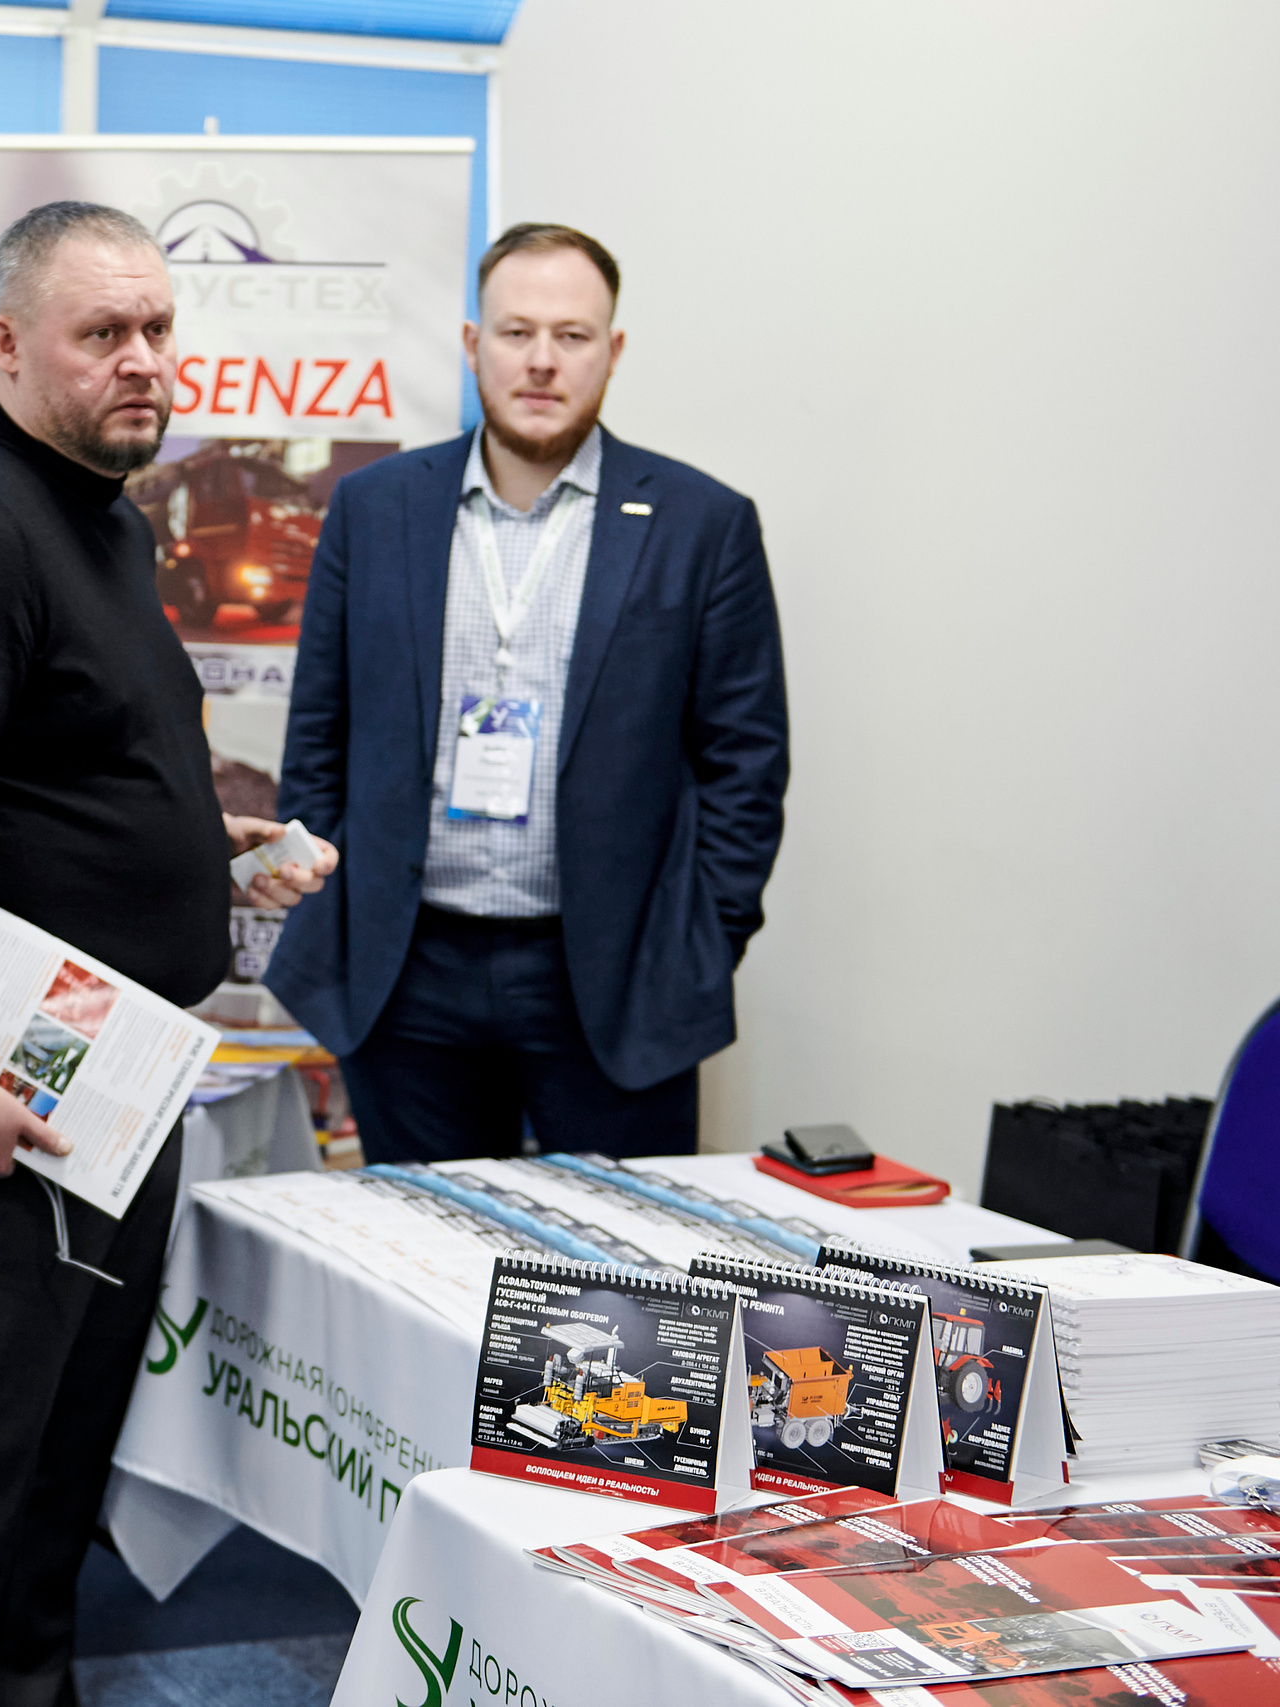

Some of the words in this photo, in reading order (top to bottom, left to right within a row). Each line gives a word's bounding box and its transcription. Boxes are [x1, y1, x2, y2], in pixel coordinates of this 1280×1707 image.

[498, 1275, 581, 1297] АСФАЛЬТОУКЛАДЧИК
[496, 1287, 547, 1304] ГУСЕНИЧНЫЙ
[494, 1298, 531, 1311] АСФ-Г-4-04
[532, 1304, 537, 1312] С
[537, 1305, 569, 1318] ГАЗОВЫМ
[570, 1310, 610, 1324] ОБОГРЕВОМ
[700, 1307, 730, 1320] ГКМП
[749, 1299, 785, 1316] РЕМОНТА
[1007, 1305, 1034, 1318] ГКМП
[887, 1316, 917, 1330] ГКМП
[489, 1333, 522, 1344] ПЛАТФОРМА
[209, 1307, 324, 1396] ДОРОЖНАЯ
[489, 1341, 518, 1352] ОПЕРАТОРА
[671, 1349, 697, 1360] СИЛОВОЙ
[696, 1353, 720, 1363] АГРЕГАТ
[689, 1371, 718, 1382] КОНВЕЙЕР
[861, 1363, 887, 1376] РАБОЧИЙ
[886, 1368, 905, 1379] ОРГАН
[483, 1376, 504, 1386] НАГРЕВ
[670, 1376, 717, 1390] ДВУХЛЕНТОЧНЫЙ
[866, 1397, 900, 1411] УПРАВЛЕНИЯ
[883, 1392, 901, 1402] ПУЛЬТ
[480, 1404, 503, 1415] РАБОЧАЯ
[202, 1351, 374, 1511] УРАЛЬСКИЙ
[689, 1426, 711, 1437] БУНКЕР
[983, 1429, 1010, 1442] НАВЕСНОЕ
[991, 1422, 1011, 1434] ЗАДНЕЕ
[968, 1434, 1009, 1451] ОБОРУДОВАНИЕ
[841, 1442, 892, 1461] ЖИДКОТОПЛИВНАЯ
[624, 1456, 645, 1467] ШНЕКИ
[673, 1455, 708, 1468] ГУСЕНИЧНЫЙ
[865, 1456, 891, 1469] ГОРЕЛКА
[674, 1464, 707, 1476] ДВИЖИТЕЛЬ
[525, 1464, 575, 1481] ВОПЛОЩАЕМ
[576, 1473, 598, 1486] ИДЕИ
[598, 1477, 605, 1487] В
[605, 1478, 660, 1496] РЕАЛЬНОСТЬ!
[754, 1471, 776, 1484] ИДЕИ
[776, 1476, 783, 1485] В
[835, 1519, 886, 1544] ТЕХНИКА
[845, 1518, 933, 1556] СТРОИТЕЛЬНАЯ
[854, 1515, 918, 1544] ДОРОЖНО-
[952, 1557, 998, 1586] ТЕХНИКА
[977, 1554, 1032, 1590] ДОРОЖНО-
[965, 1556, 1041, 1604] СТРОИТЕЛЬНАЯ
[760, 1592, 814, 1631] РЕАЛЬНОСТЬ
[1151, 1619, 1203, 1643] ГКМП
[1106, 1665, 1150, 1697] ЕХНИКА
[1135, 1661, 1188, 1703] ОРОЖНО-
